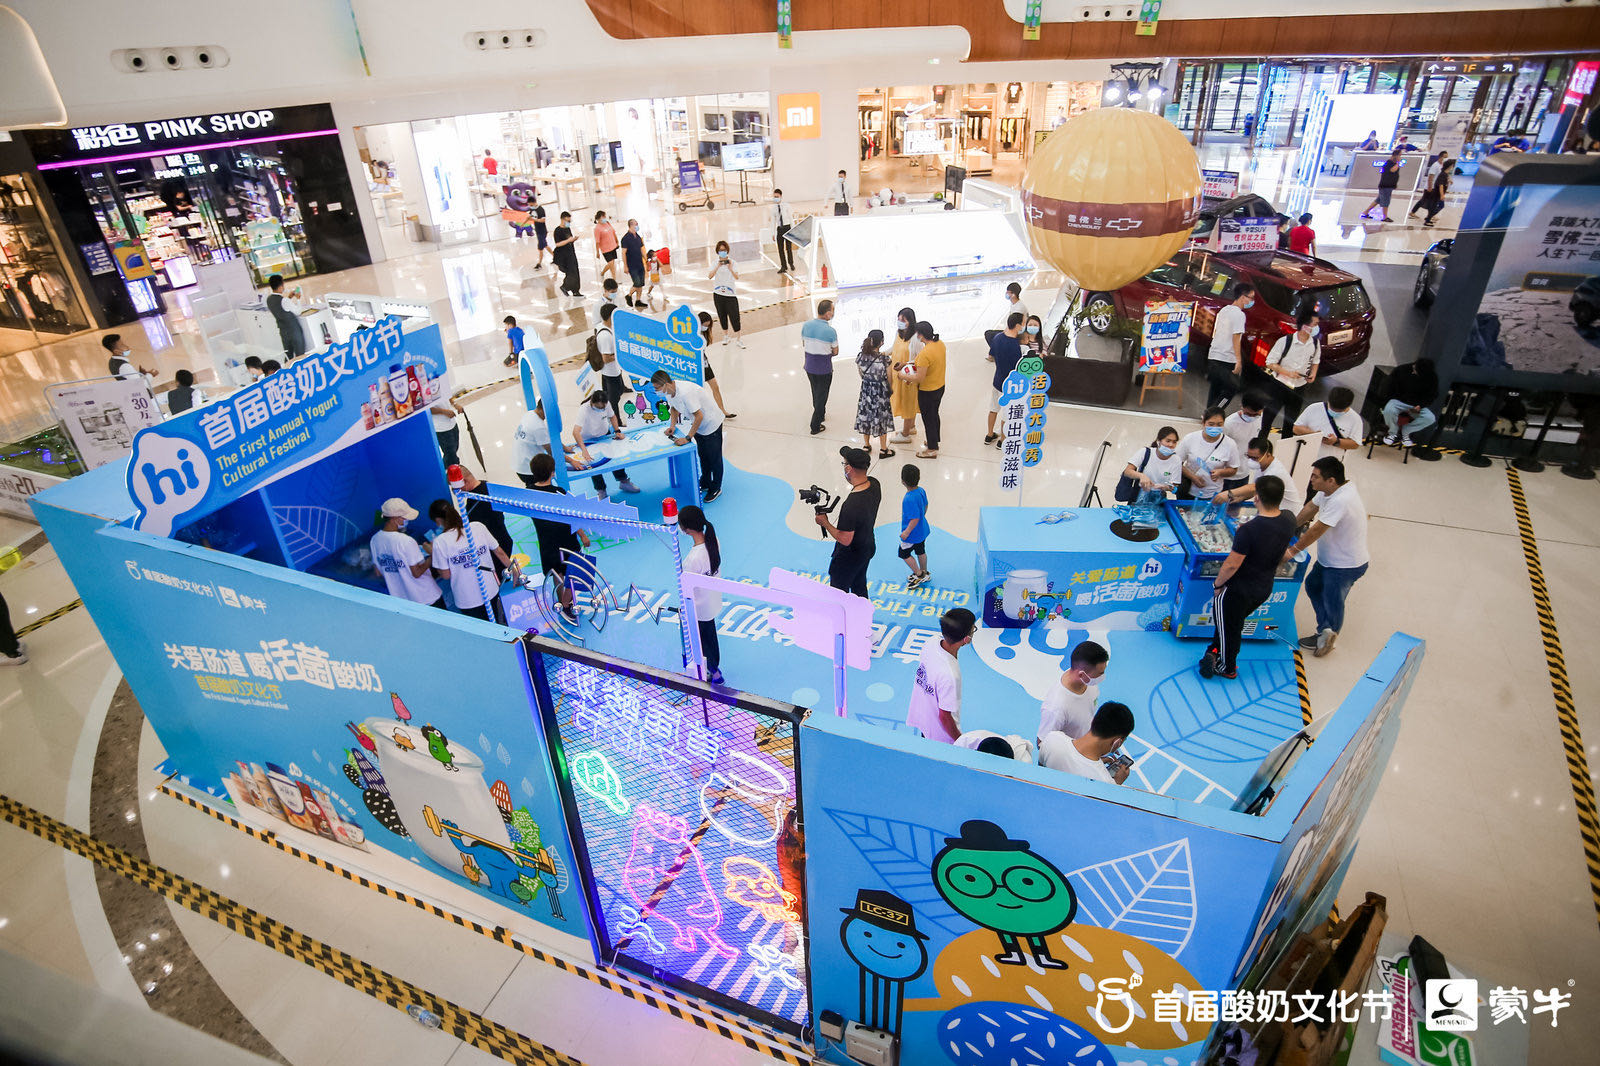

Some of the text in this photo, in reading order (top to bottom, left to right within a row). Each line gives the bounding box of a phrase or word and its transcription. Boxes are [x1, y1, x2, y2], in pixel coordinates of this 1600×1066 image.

[1463, 64, 1477, 72] 1F
[144, 117, 207, 140] PINK
[210, 110, 274, 133] SHOP
[672, 316, 692, 334] hi
[618, 339, 698, 374] 首届酸奶文化节
[198, 317, 401, 451] 首届酸奶文化节
[1007, 380, 1024, 394] hi
[131, 397, 149, 411] 30
[1026, 375, 1046, 462] 活菌大咖秀
[215, 394, 339, 473] The First Annual Yogurt
[1002, 404, 1024, 489] 撞出新滋味
[222, 426, 311, 488] Cultural Festival
[142, 448, 199, 505] hi
[1069, 564, 1138, 586] 关爱肠道
[1144, 563, 1160, 574] hi
[1074, 581, 1170, 606] 喝活菌酸奶
[163, 638, 383, 693] 关爱肠道 喝活菌酸奶
[866, 904, 904, 921] LC-37
